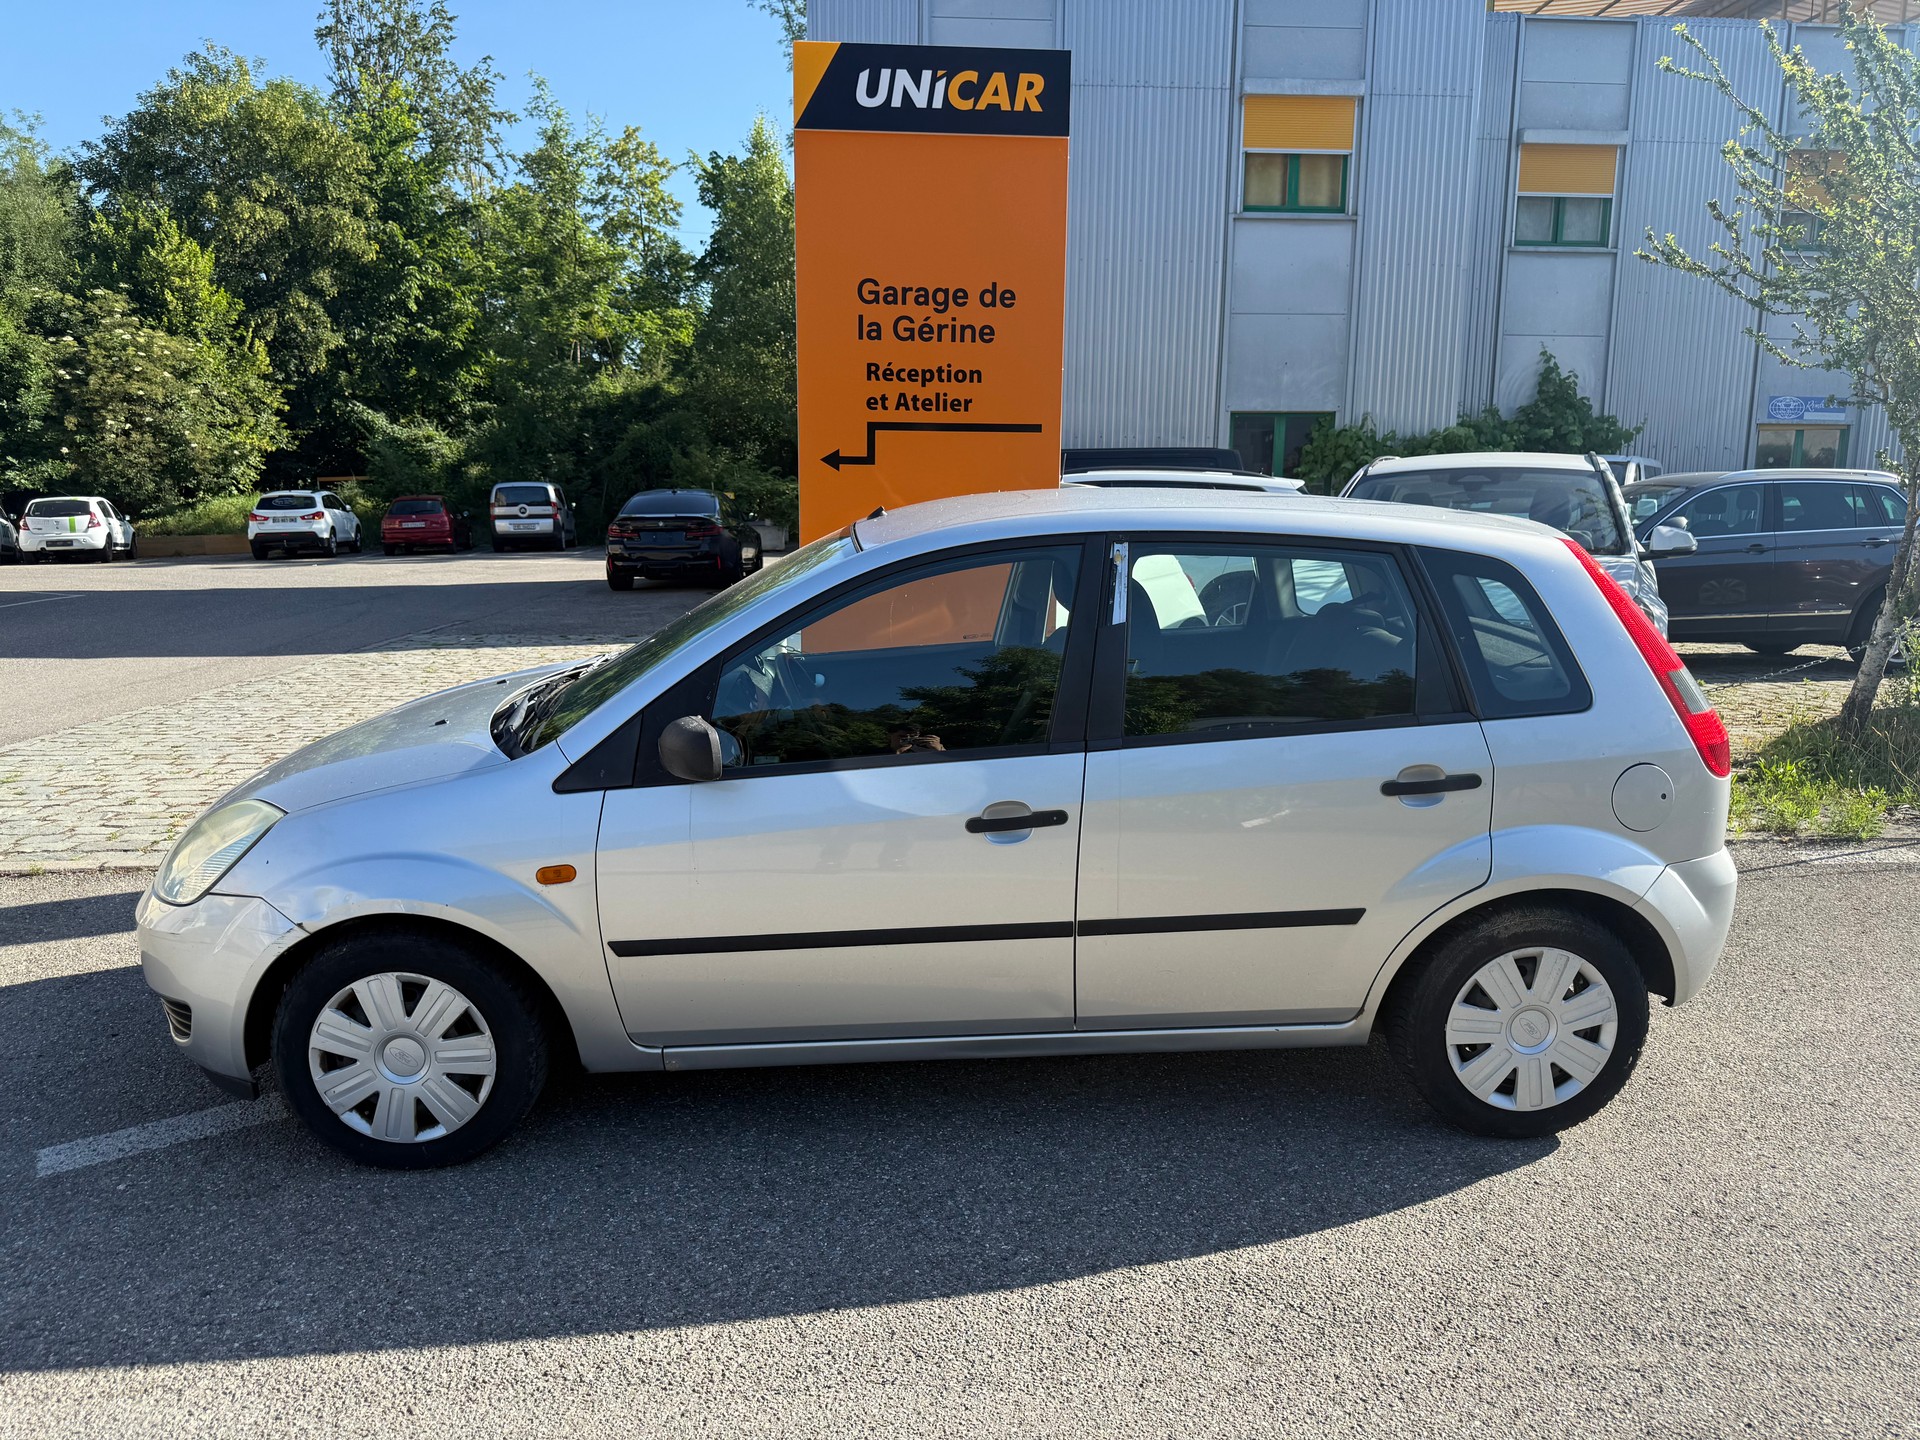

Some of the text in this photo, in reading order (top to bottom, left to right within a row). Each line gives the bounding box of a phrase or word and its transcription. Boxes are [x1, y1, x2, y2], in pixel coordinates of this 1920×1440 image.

[857, 278, 1016, 314] Garage de
[857, 314, 995, 344] la Gérine
[866, 362, 982, 387] Réception
[866, 392, 973, 412] et Atelier
